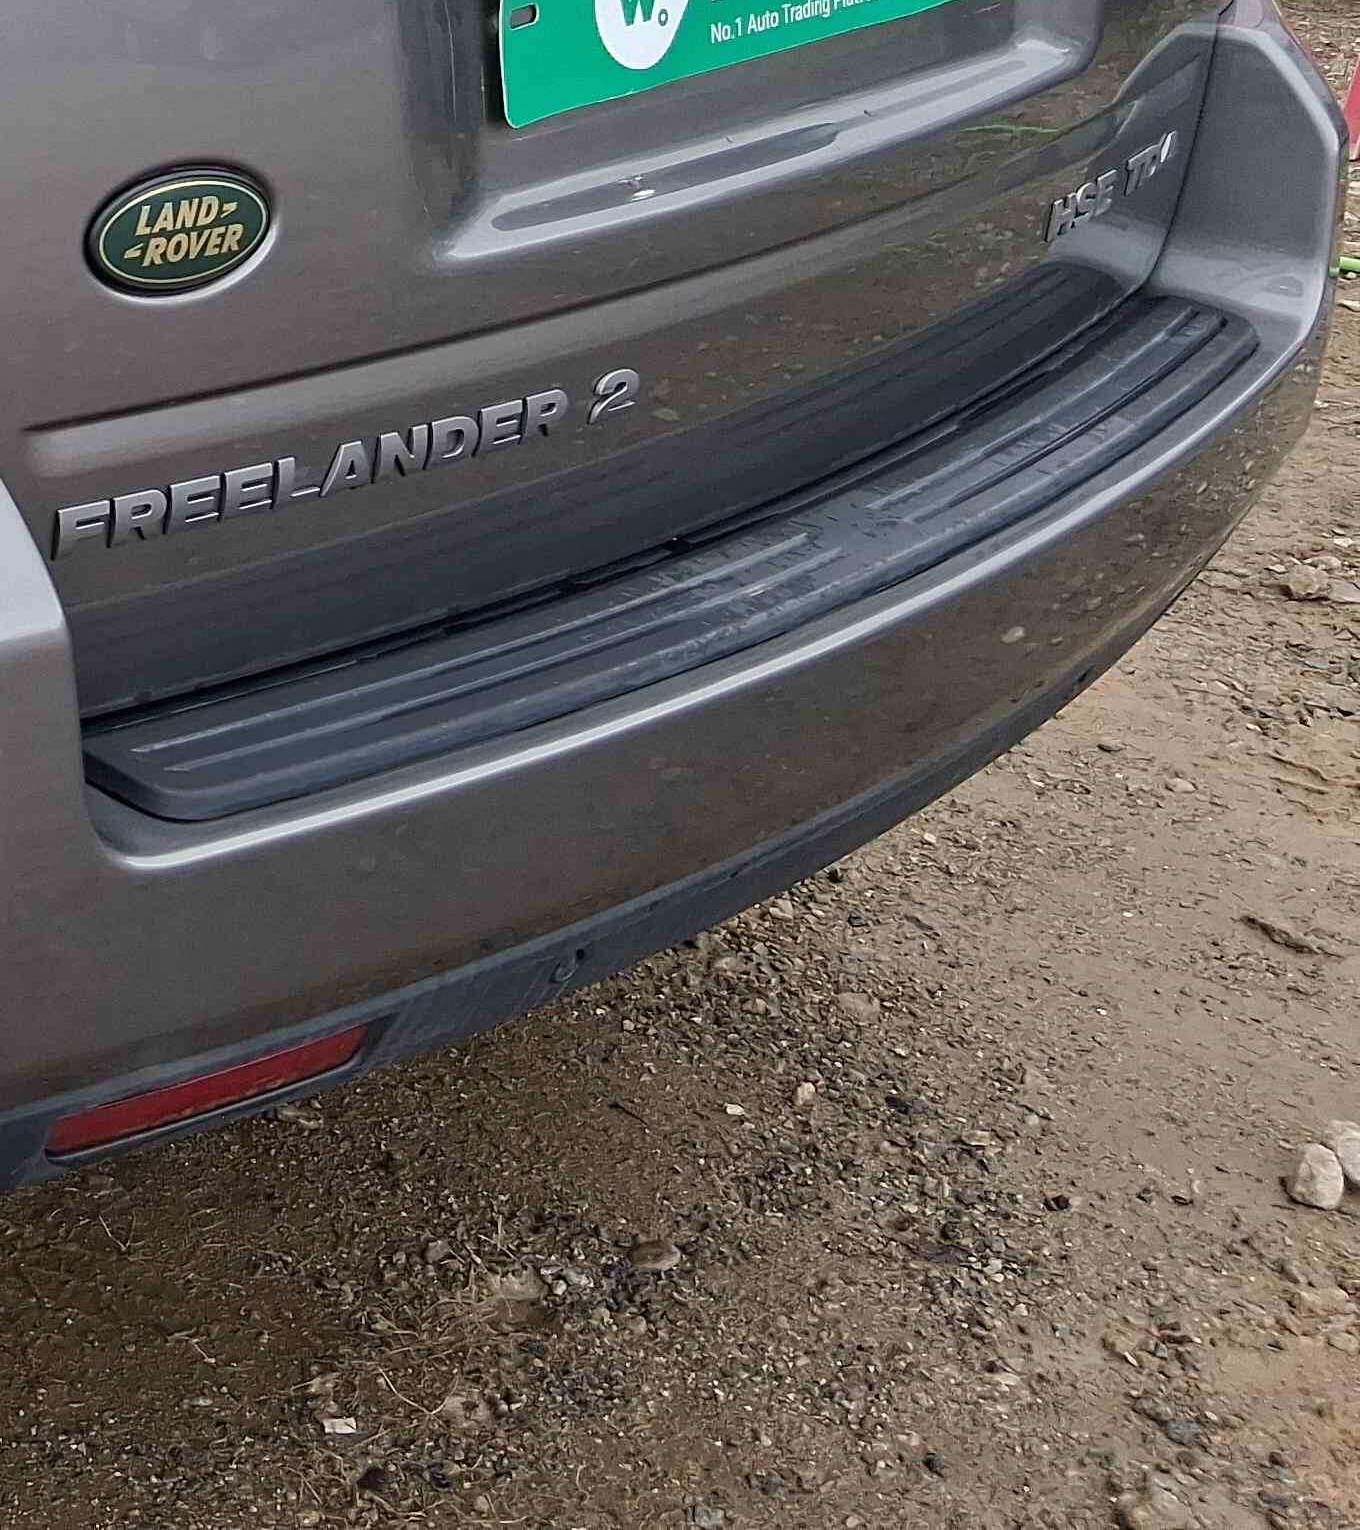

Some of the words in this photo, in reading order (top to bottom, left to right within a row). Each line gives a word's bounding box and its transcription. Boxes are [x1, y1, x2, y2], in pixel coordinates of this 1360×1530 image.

[710, 15, 743, 45] No.1
[747, 11, 779, 35] Auto
[135, 195, 219, 236] LAND
[1043, 168, 1118, 243] HSE
[142, 223, 244, 267] ROVER
[50, 388, 569, 560] FREELANDER
[587, 368, 640, 426] 2
